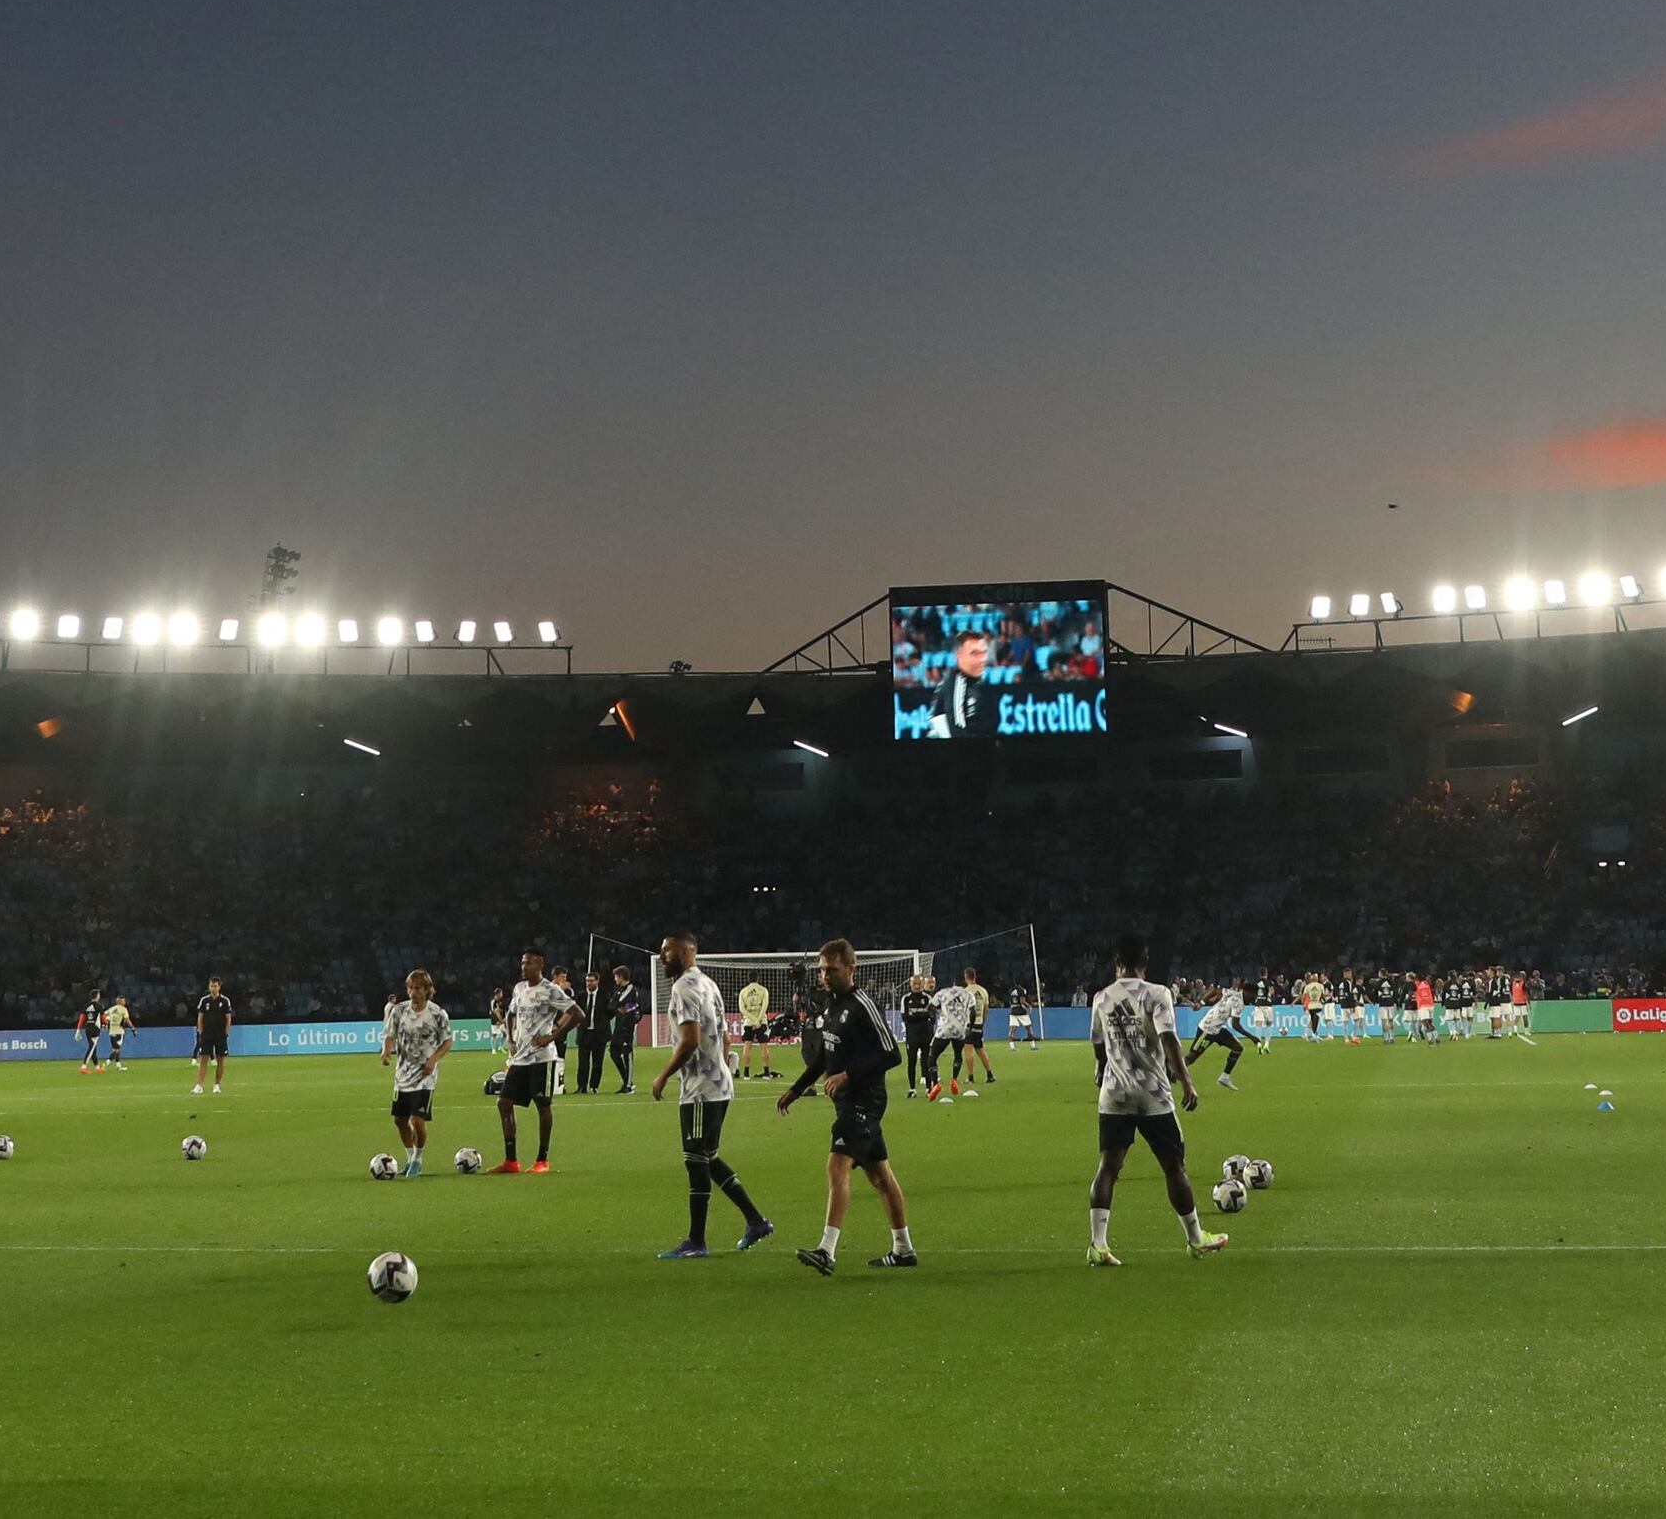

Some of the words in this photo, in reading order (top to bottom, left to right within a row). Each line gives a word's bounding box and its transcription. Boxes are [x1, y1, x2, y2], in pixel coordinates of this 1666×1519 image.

[996, 692, 1093, 736] Estrella
[11, 1038, 48, 1051] Bosch
[268, 1030, 290, 1047] Lo
[297, 1025, 358, 1046] último
